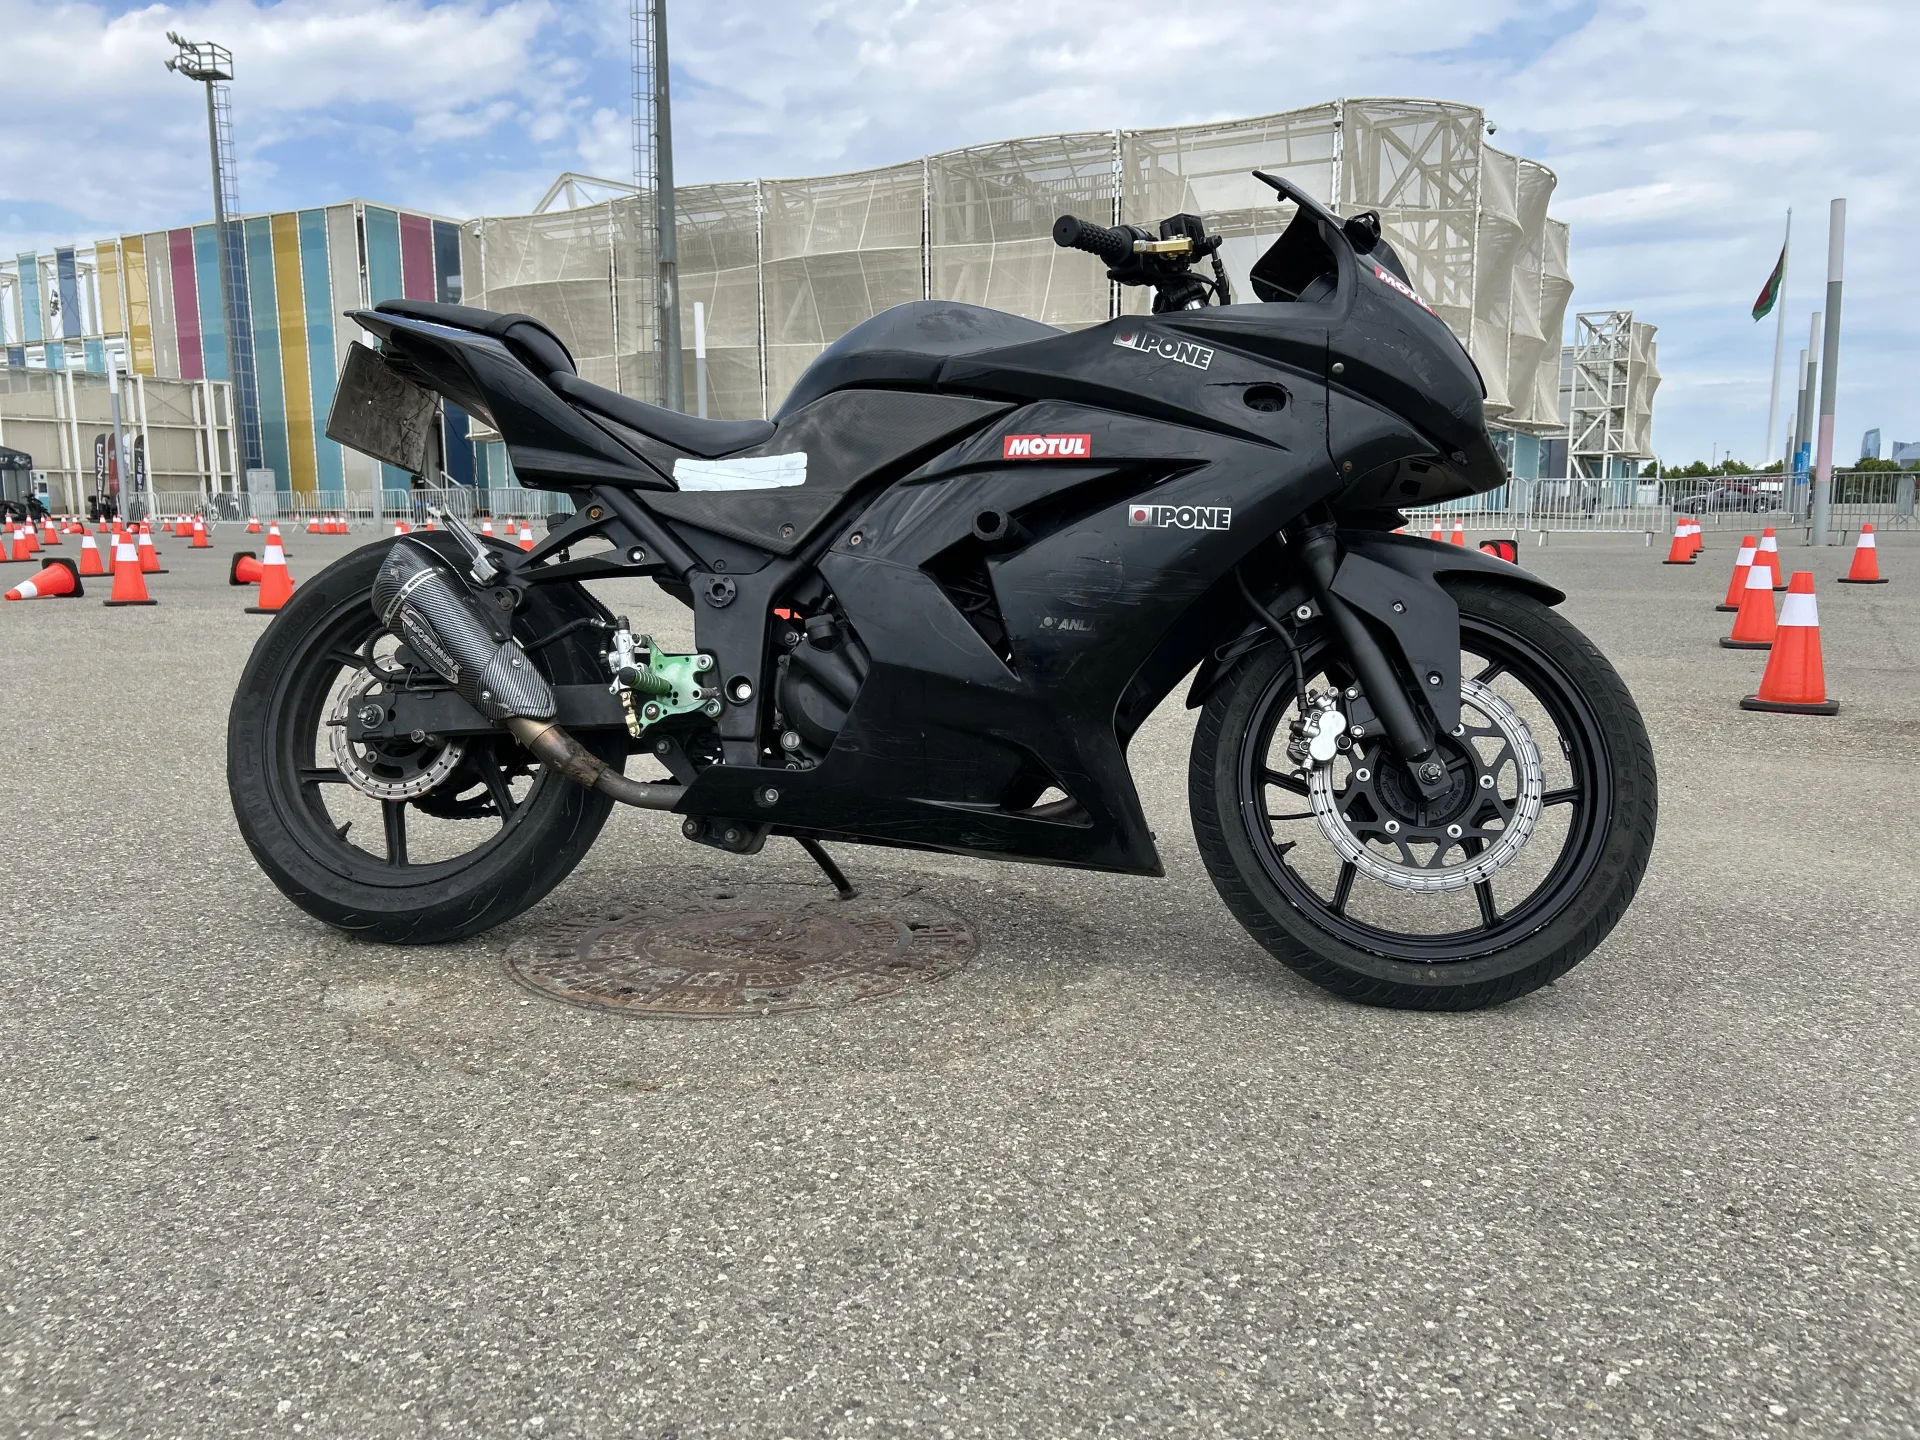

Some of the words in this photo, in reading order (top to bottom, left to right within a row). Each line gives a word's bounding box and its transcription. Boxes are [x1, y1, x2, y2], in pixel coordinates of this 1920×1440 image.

[1134, 331, 1214, 370] IPONE
[1008, 438, 1085, 455] MOTUL
[1150, 505, 1231, 530] IPONE
